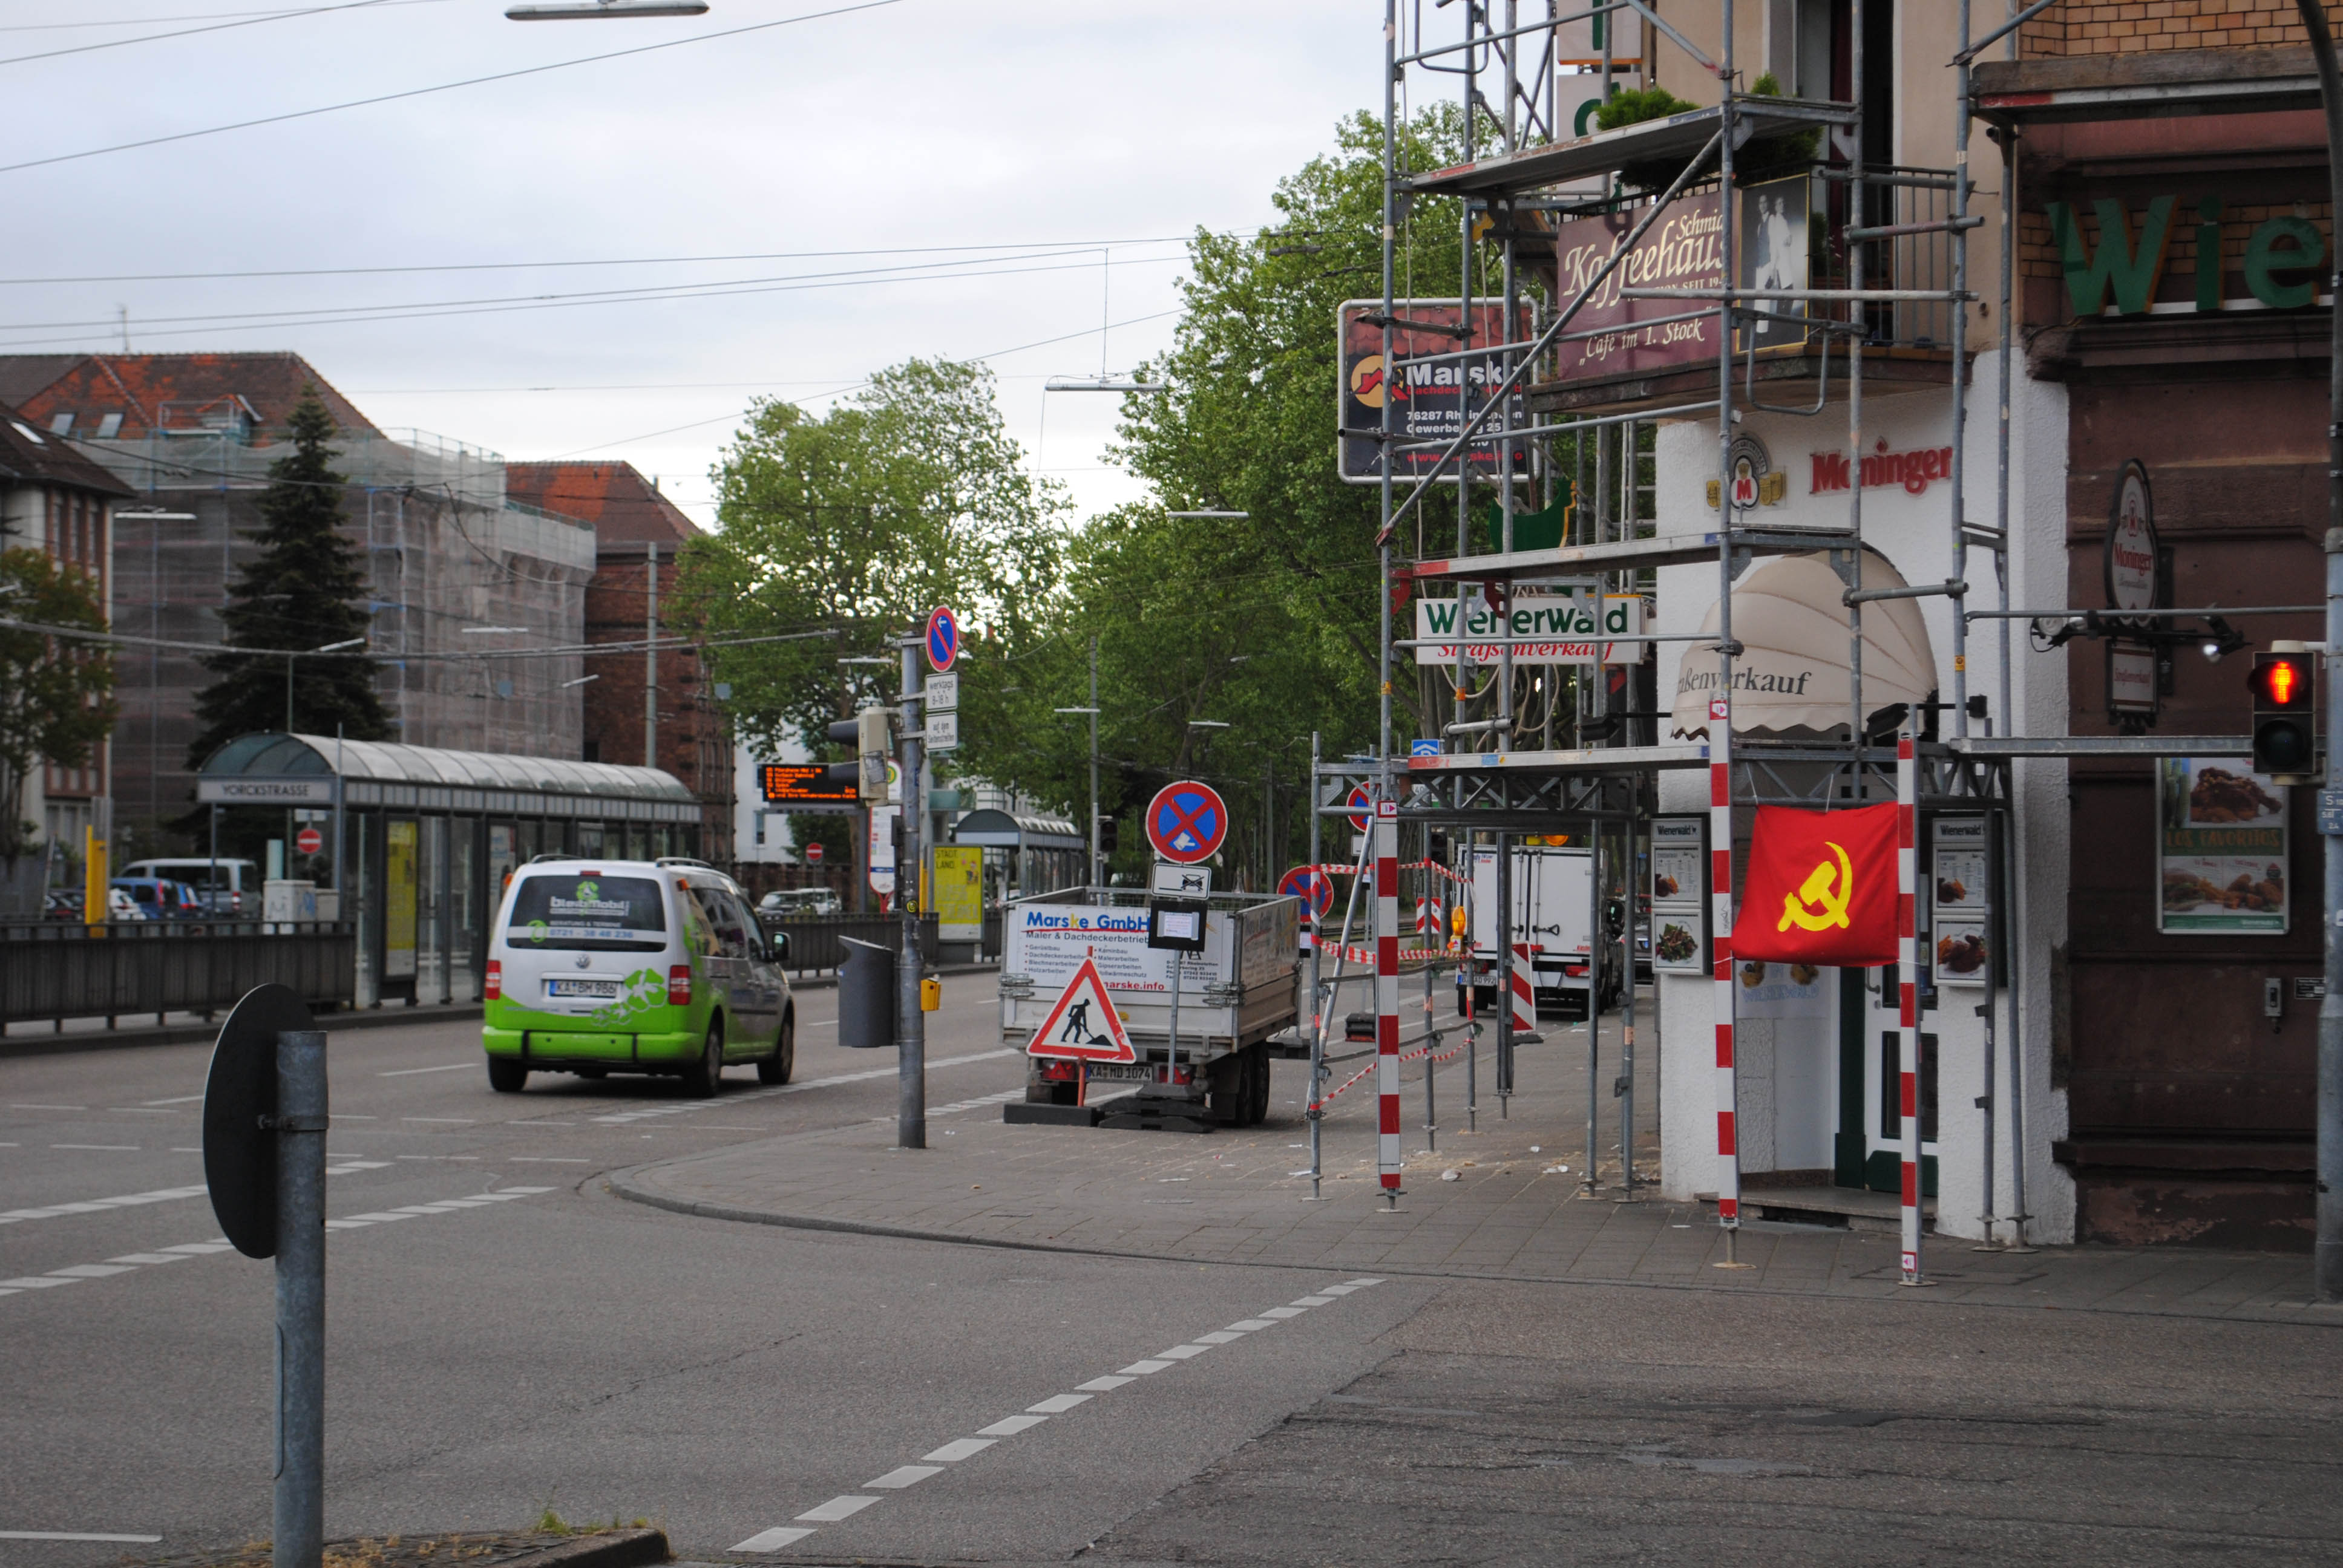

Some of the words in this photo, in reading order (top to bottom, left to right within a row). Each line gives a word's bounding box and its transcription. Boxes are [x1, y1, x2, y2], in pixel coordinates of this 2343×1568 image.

[1622, 331, 1637, 350] im
[1645, 326, 1656, 345] 1.
[1406, 411, 1442, 421] 76287
[1657, 825, 1691, 835] Wienerwald
[1940, 825, 1982, 836] Wienerwald
[1027, 911, 1089, 929] Marske
[1097, 914, 1150, 931] GmbH
[1064, 932, 1150, 944] Dachdeckerbetrieb
[1090, 1065, 1101, 1077] KA
[1110, 1067, 1122, 1079] MD
[1126, 1067, 1150, 1079] 1074
